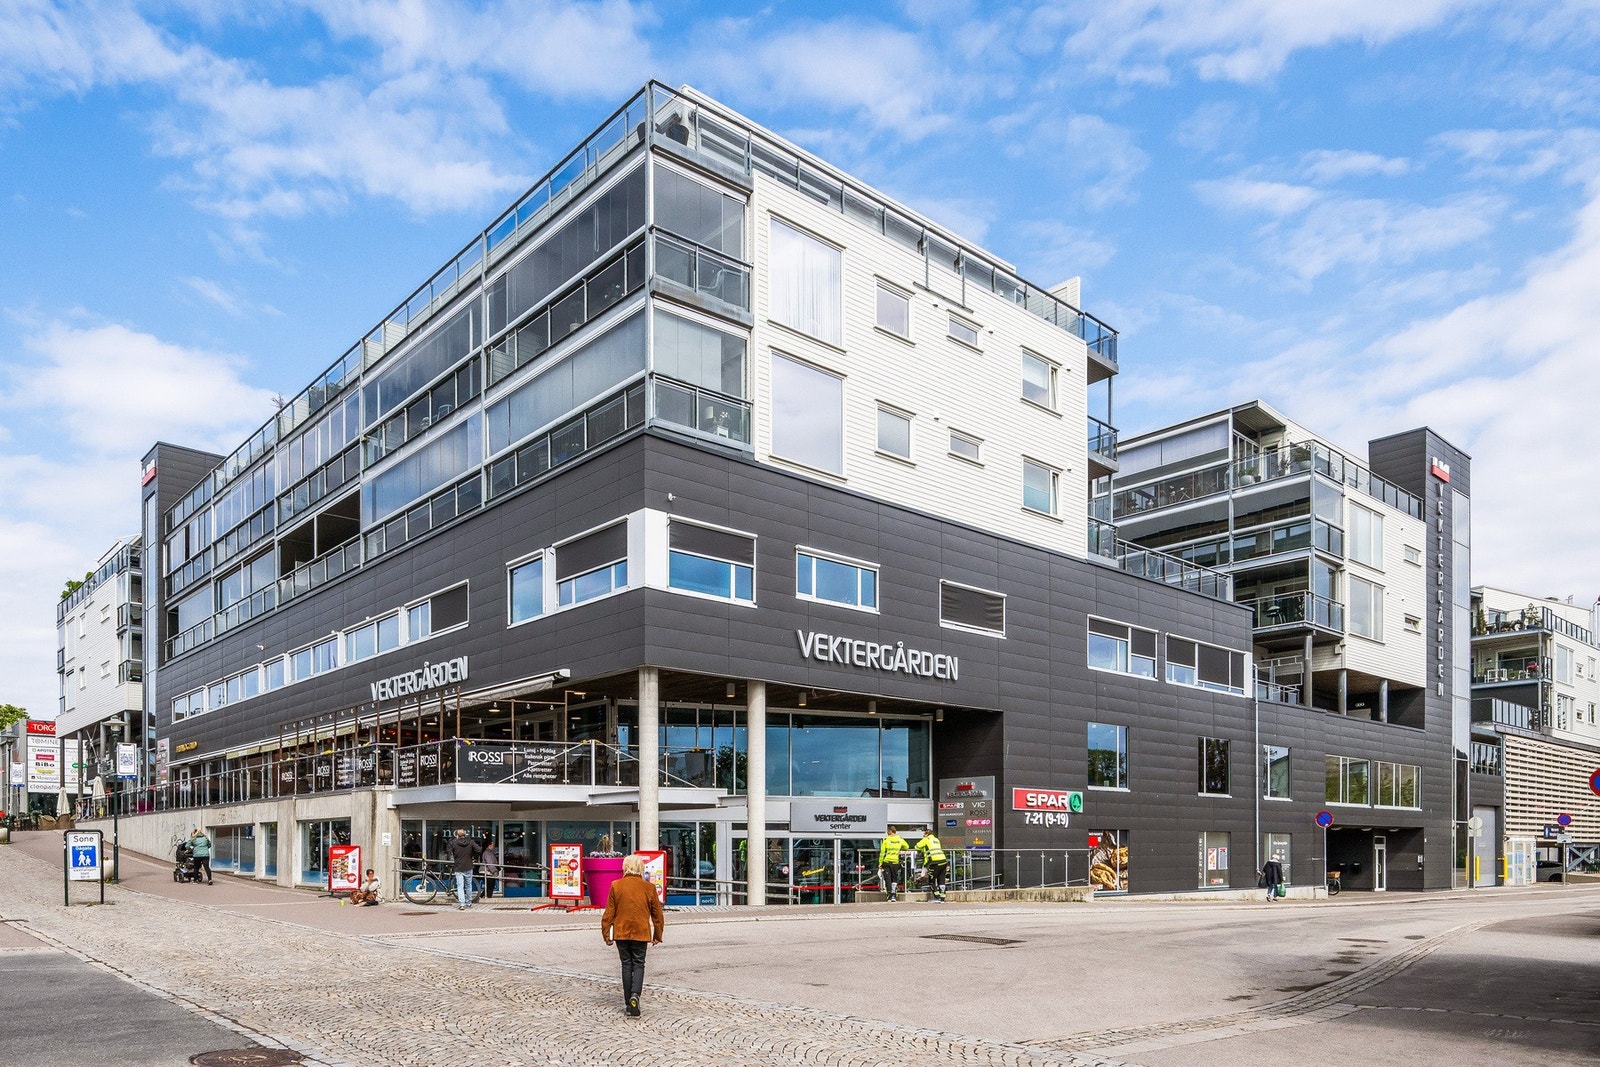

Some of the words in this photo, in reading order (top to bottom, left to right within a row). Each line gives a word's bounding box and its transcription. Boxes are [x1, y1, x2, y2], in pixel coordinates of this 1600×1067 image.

[797, 629, 959, 681] VEKTERGÅRDEN
[370, 655, 469, 701] VEKTERGÅRDEN
[420, 754, 438, 766] ROSSI
[470, 751, 503, 762] ROSSI
[1026, 793, 1068, 807] SPAR
[814, 814, 867, 822] VEKTERGÅRDEN
[1024, 812, 1043, 825] 7-21
[1045, 812, 1069, 828] (9-19)
[73, 835, 94, 843] Sone
